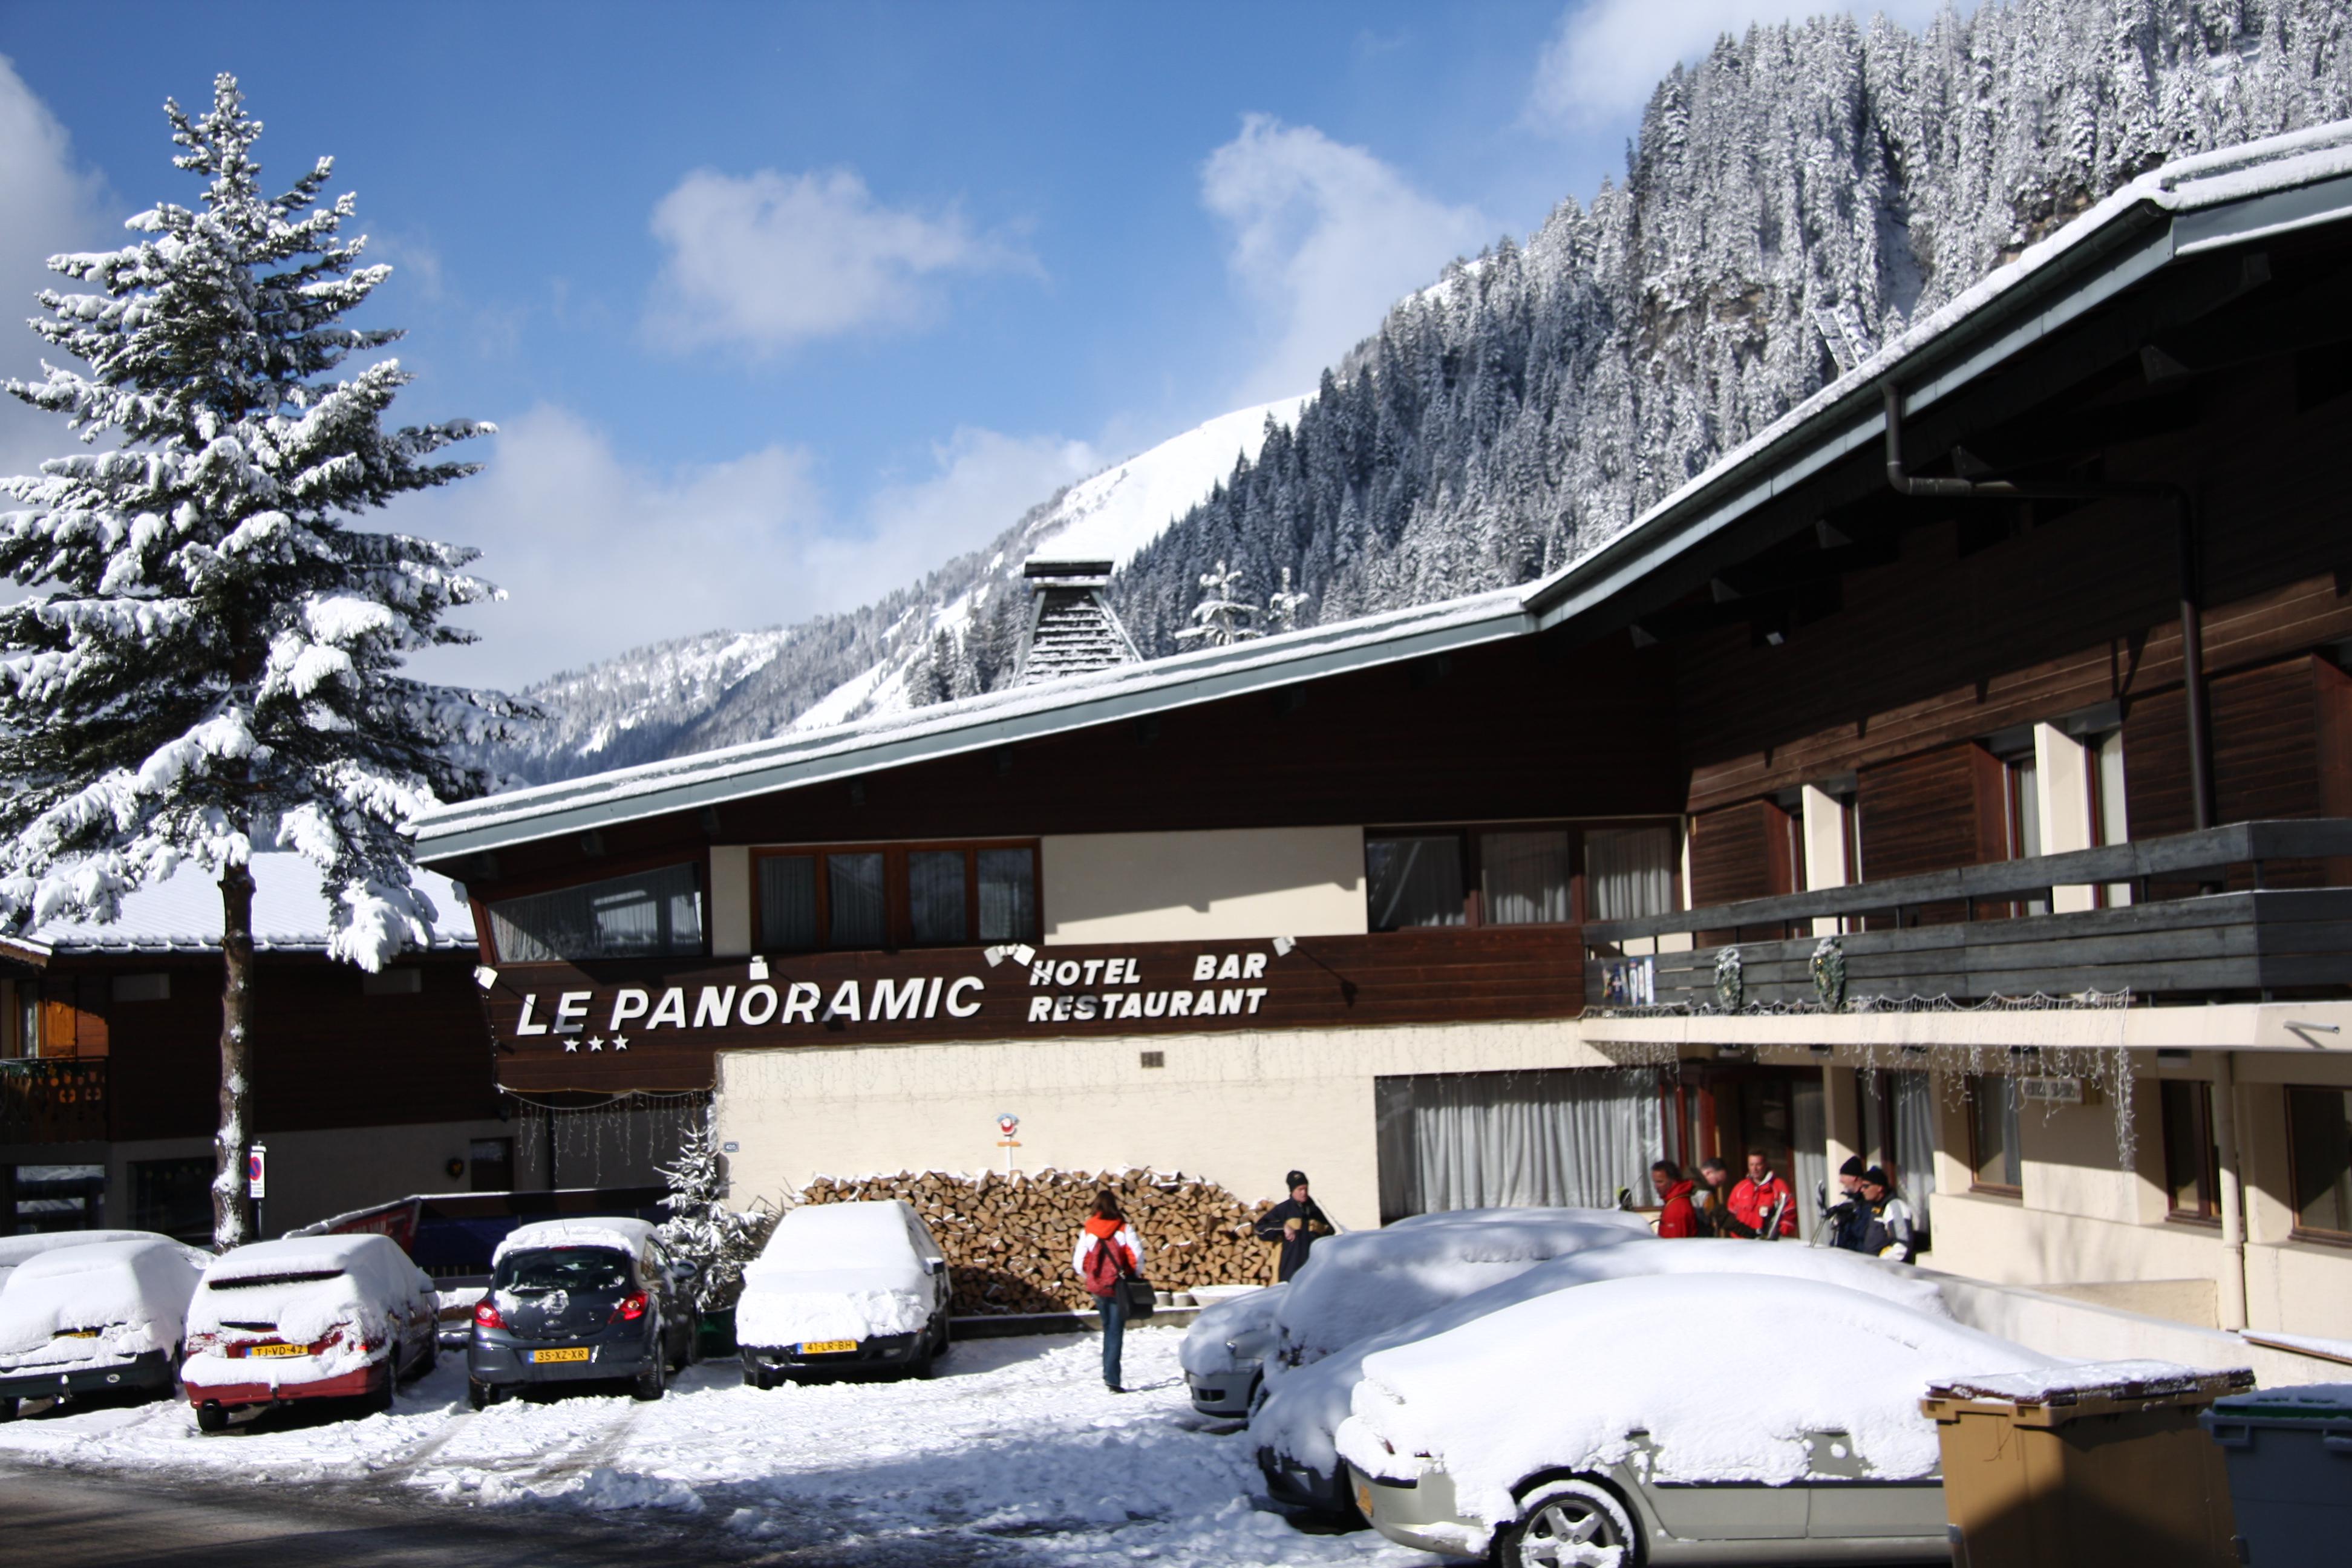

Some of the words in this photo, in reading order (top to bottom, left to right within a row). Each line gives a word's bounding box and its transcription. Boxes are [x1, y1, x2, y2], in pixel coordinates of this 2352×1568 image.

[1030, 958, 1141, 985] HOTEL
[1193, 952, 1267, 981] BAR
[517, 991, 592, 1036] LE
[609, 975, 985, 1031] PANORAMIC
[1028, 987, 1268, 1022] RESTAURANT
[256, 1345, 303, 1357] TJ-VD-42
[538, 1350, 585, 1361] 35-XZ-XR
[807, 1339, 853, 1351] 41-LR-BH
